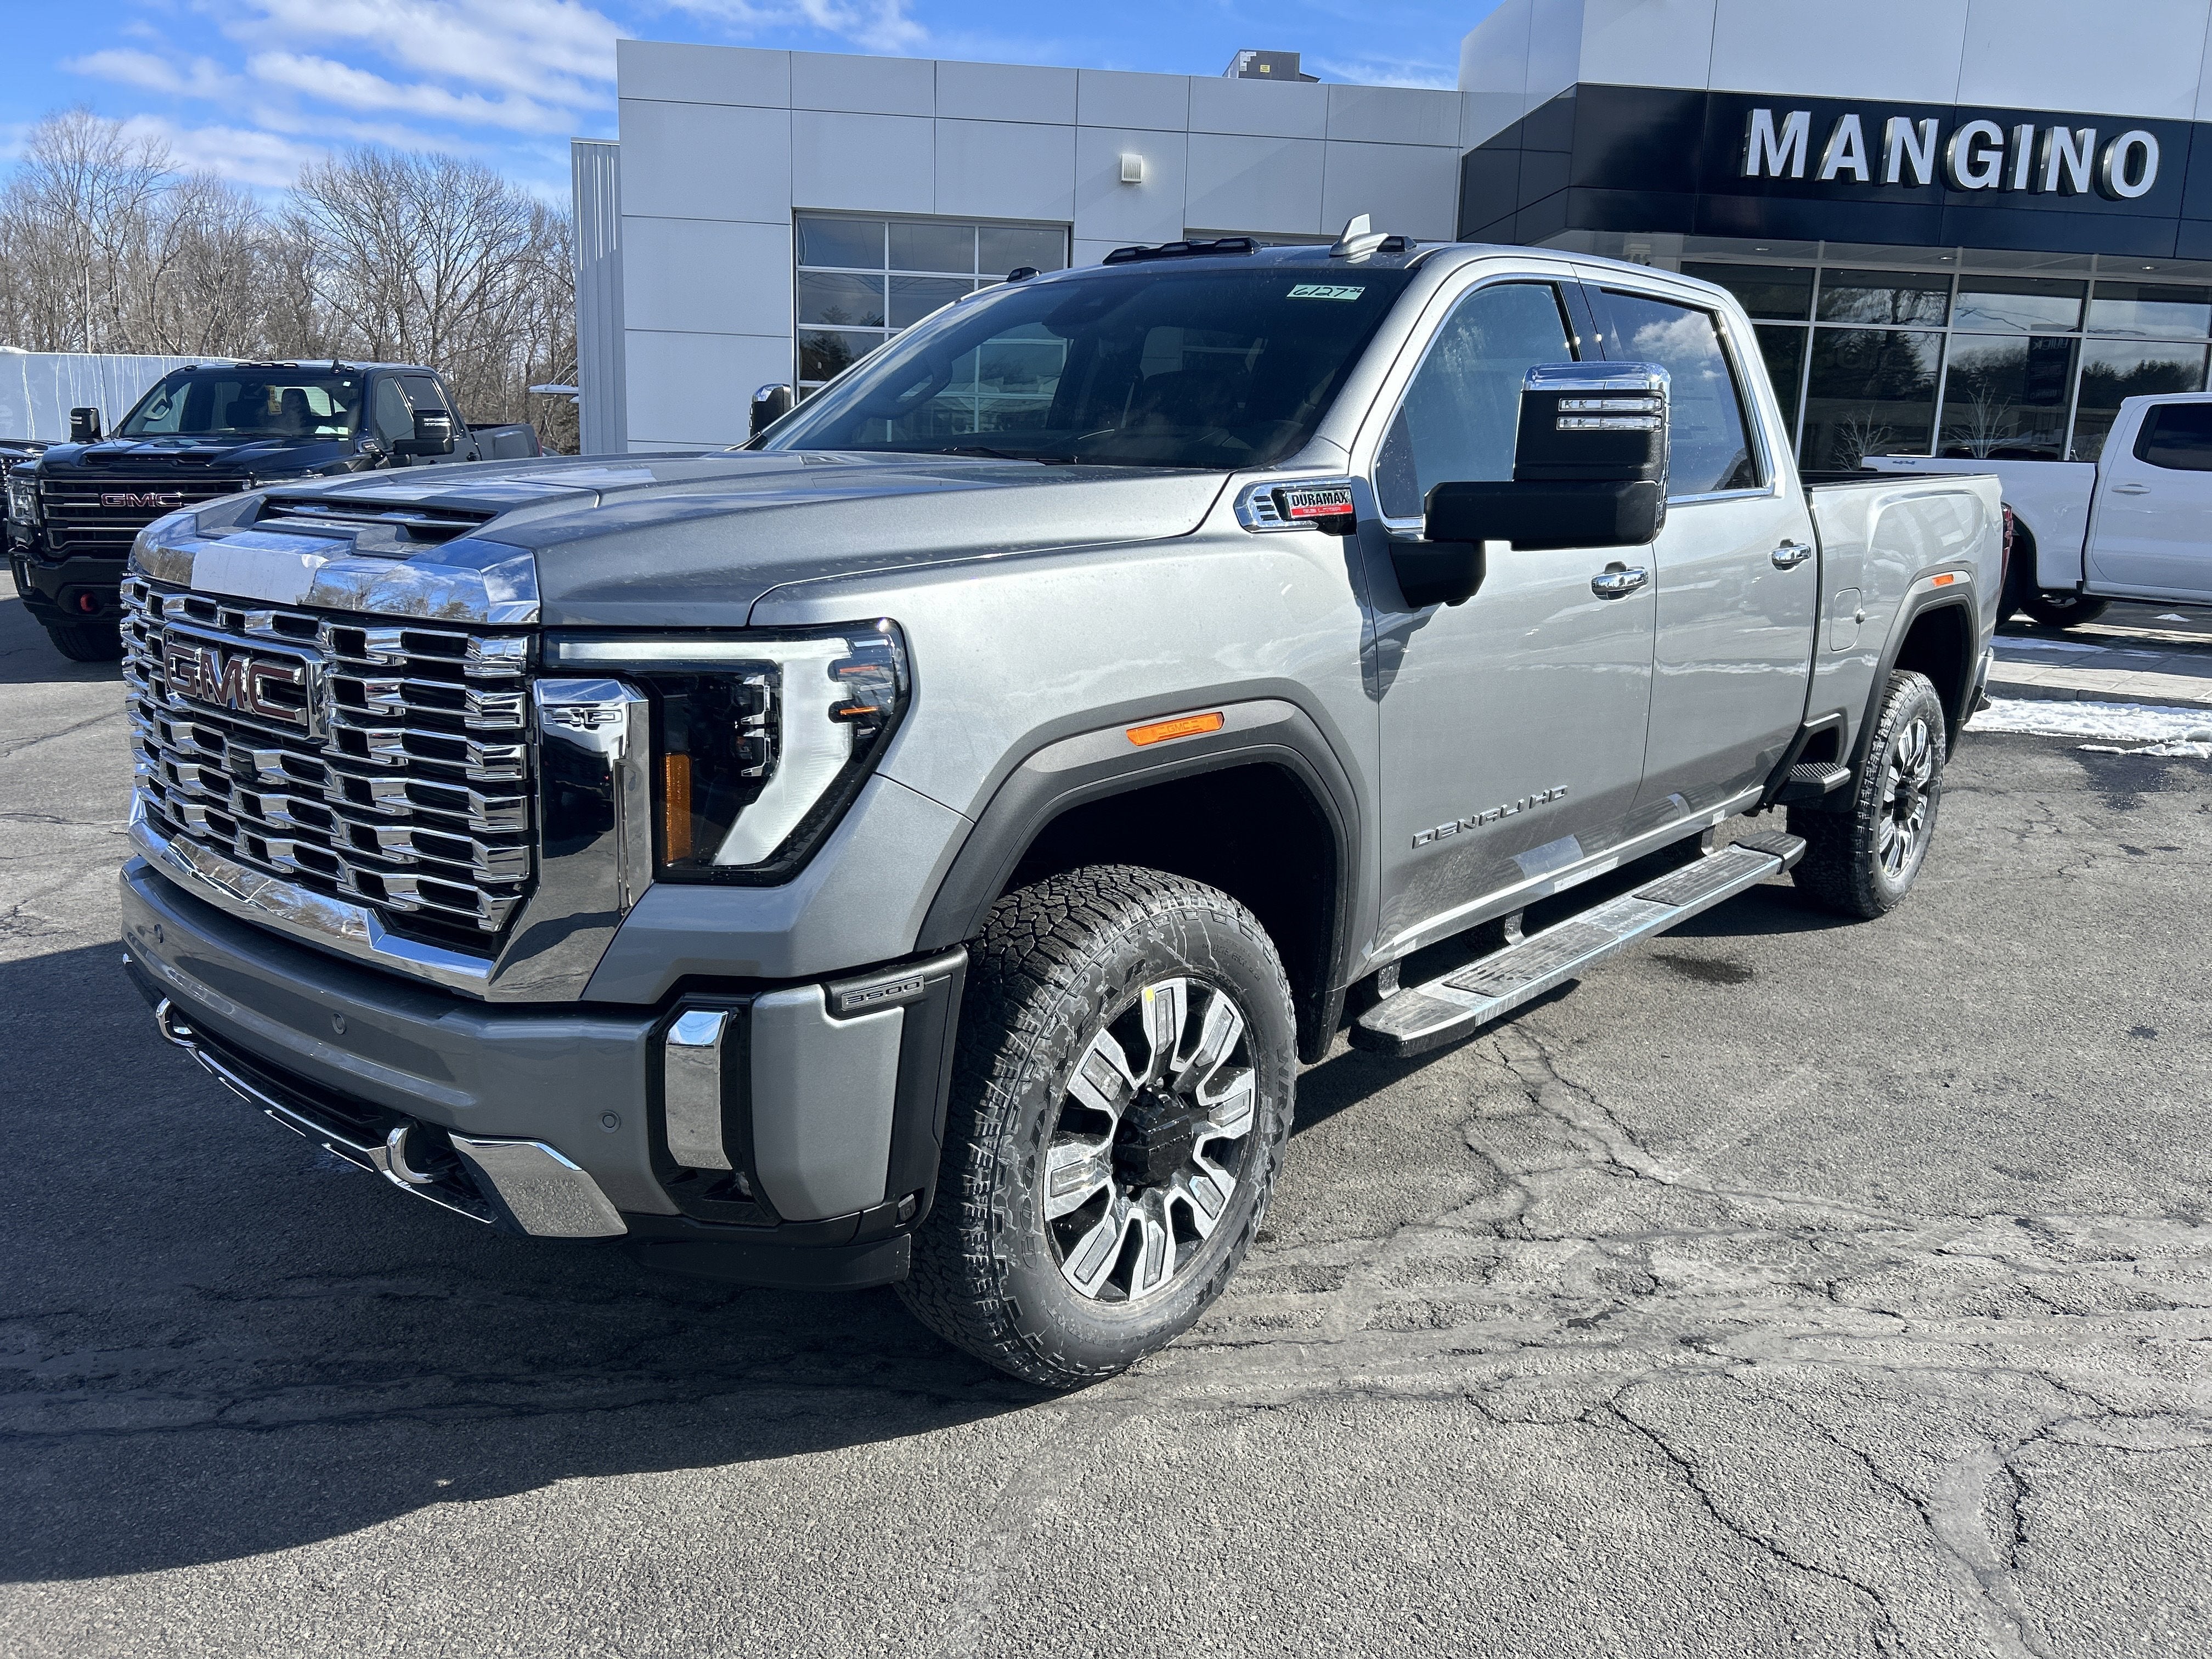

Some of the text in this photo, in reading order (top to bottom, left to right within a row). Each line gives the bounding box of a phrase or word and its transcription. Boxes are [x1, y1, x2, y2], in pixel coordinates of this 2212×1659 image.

[1740, 108, 2161, 200] MANGINO
[101, 492, 184, 507] GMC
[1291, 491, 1348, 506] DURAMAX
[165, 641, 309, 726] GMC
[1412, 785, 1568, 850] DENALI HD
[845, 981, 921, 1006] 3500
